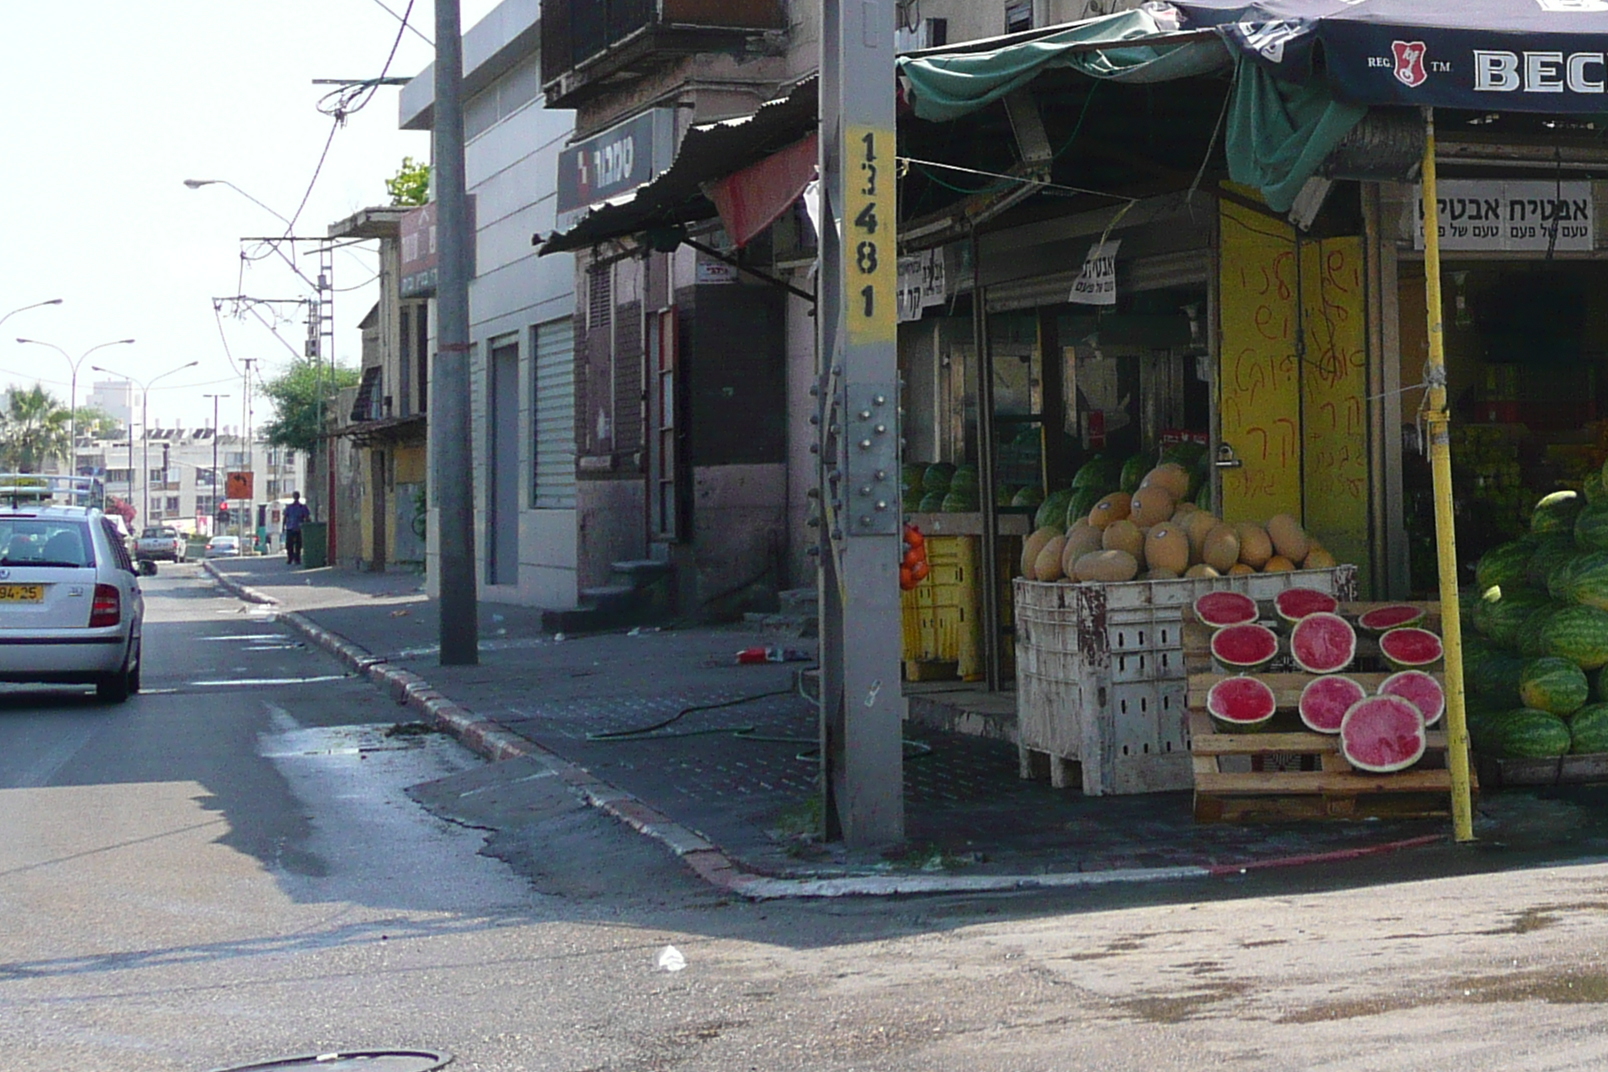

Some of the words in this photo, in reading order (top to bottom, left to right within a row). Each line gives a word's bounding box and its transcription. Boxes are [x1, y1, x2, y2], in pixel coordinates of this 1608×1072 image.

[1418, 197, 1500, 222] אבטי
[1509, 197, 1588, 222] אבטיח
[1420, 225, 1446, 238] פם
[1450, 222, 1469, 238] של
[1472, 225, 1500, 238] טעם
[1511, 225, 1537, 240] פעם
[1562, 225, 1588, 239] טעם
